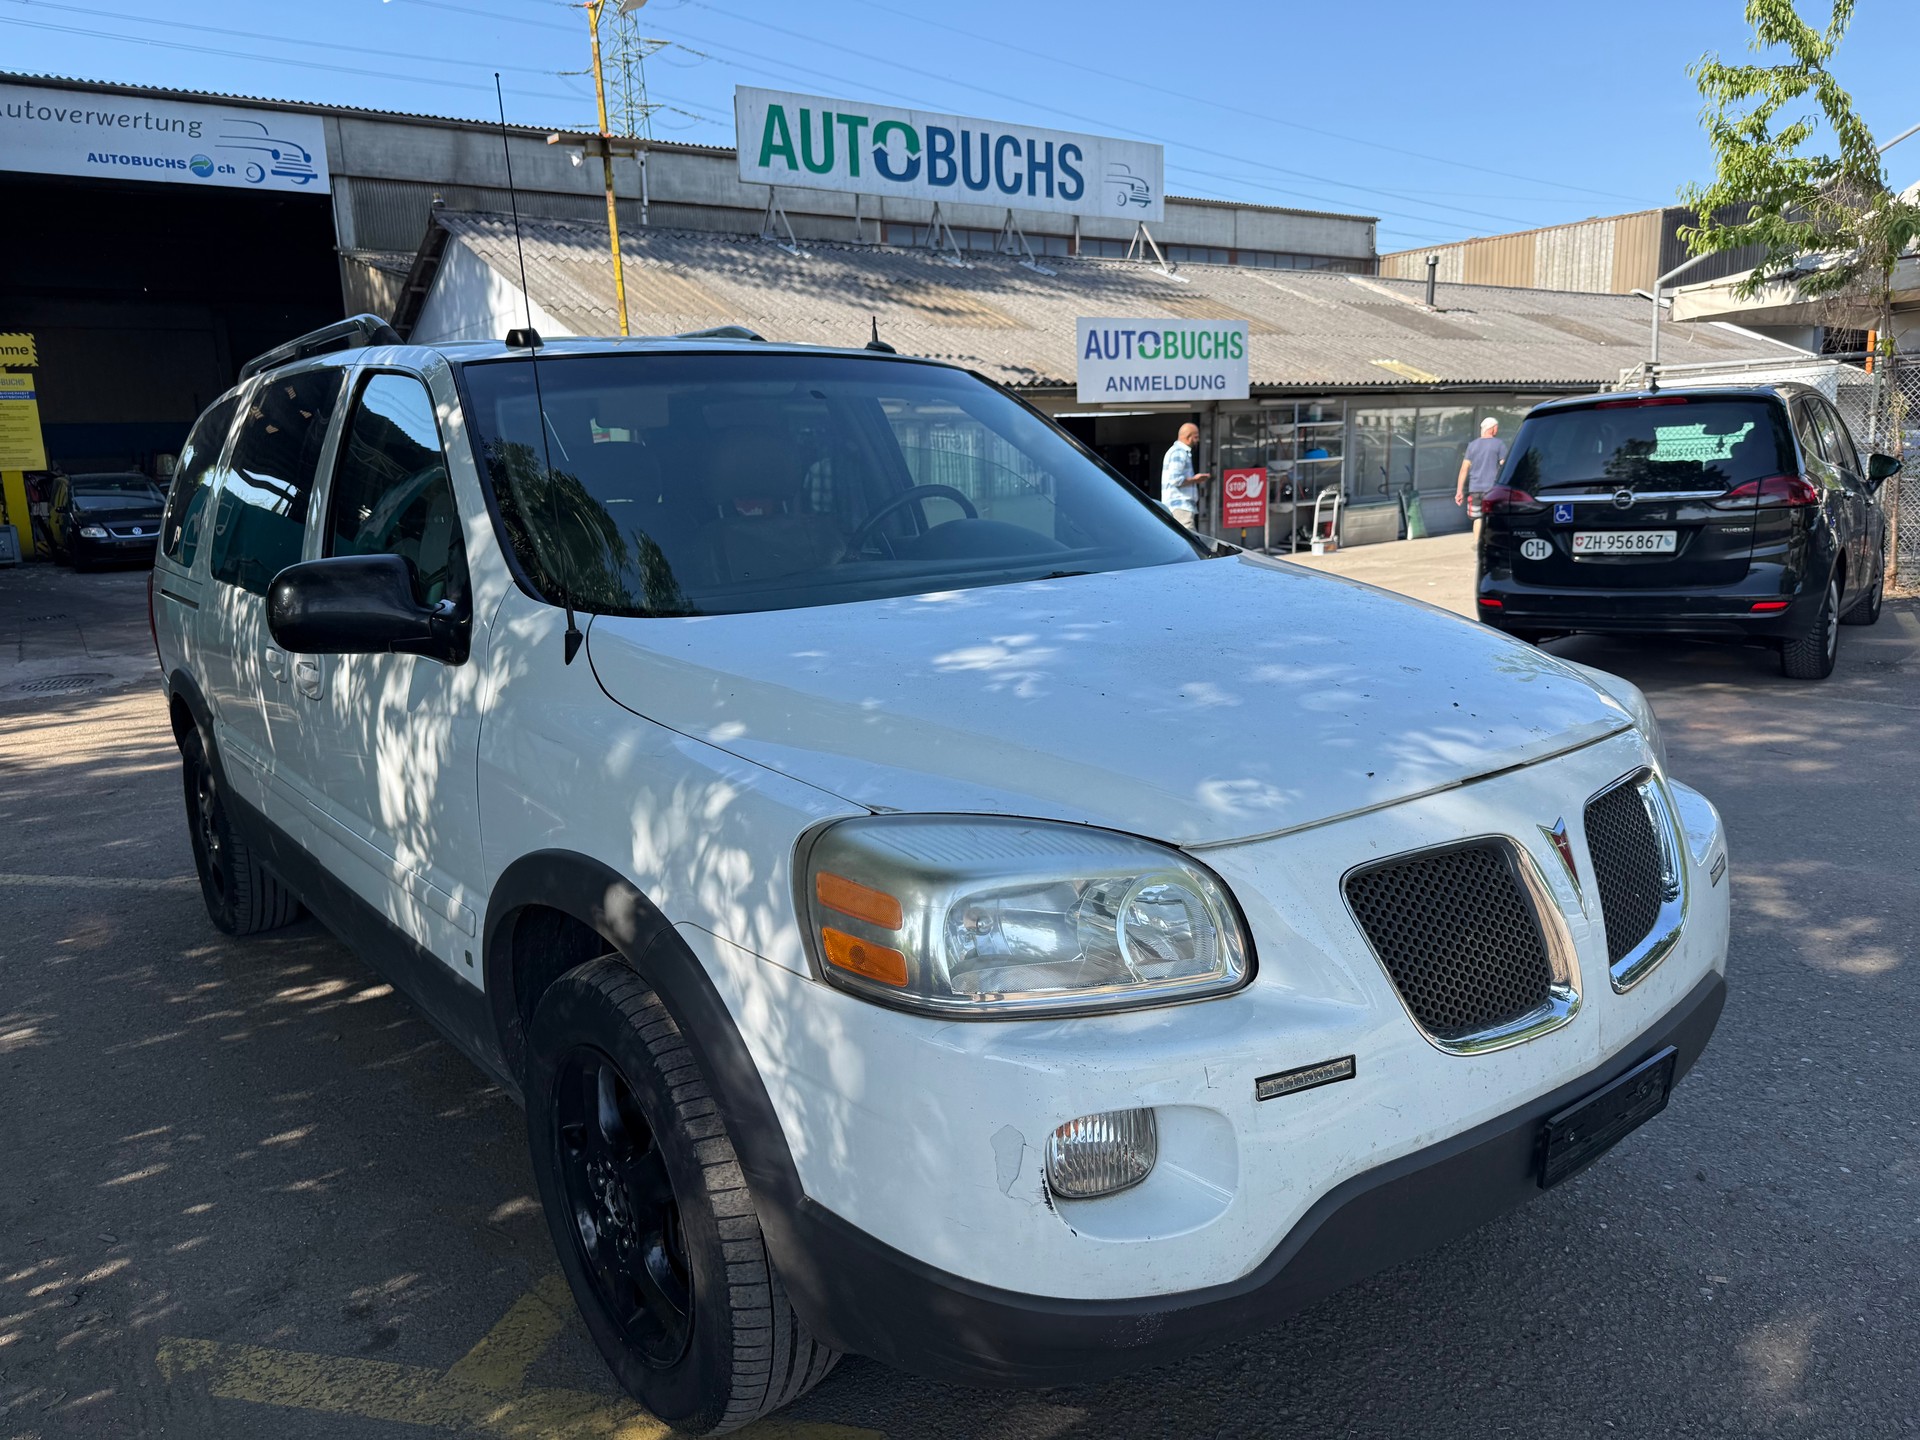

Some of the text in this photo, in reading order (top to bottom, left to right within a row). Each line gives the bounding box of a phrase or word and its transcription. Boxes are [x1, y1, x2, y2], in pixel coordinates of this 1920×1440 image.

[0, 101, 203, 138] utoverwertung
[87, 152, 187, 170] AUTOBUCHS
[758, 104, 1085, 201] AUTOBUCHS
[1084, 330, 1243, 360] AUTOBUCHS
[1105, 375, 1226, 392] ANMELDUNG
[1229, 482, 1245, 491] STOP
[1525, 541, 1546, 557] CH
